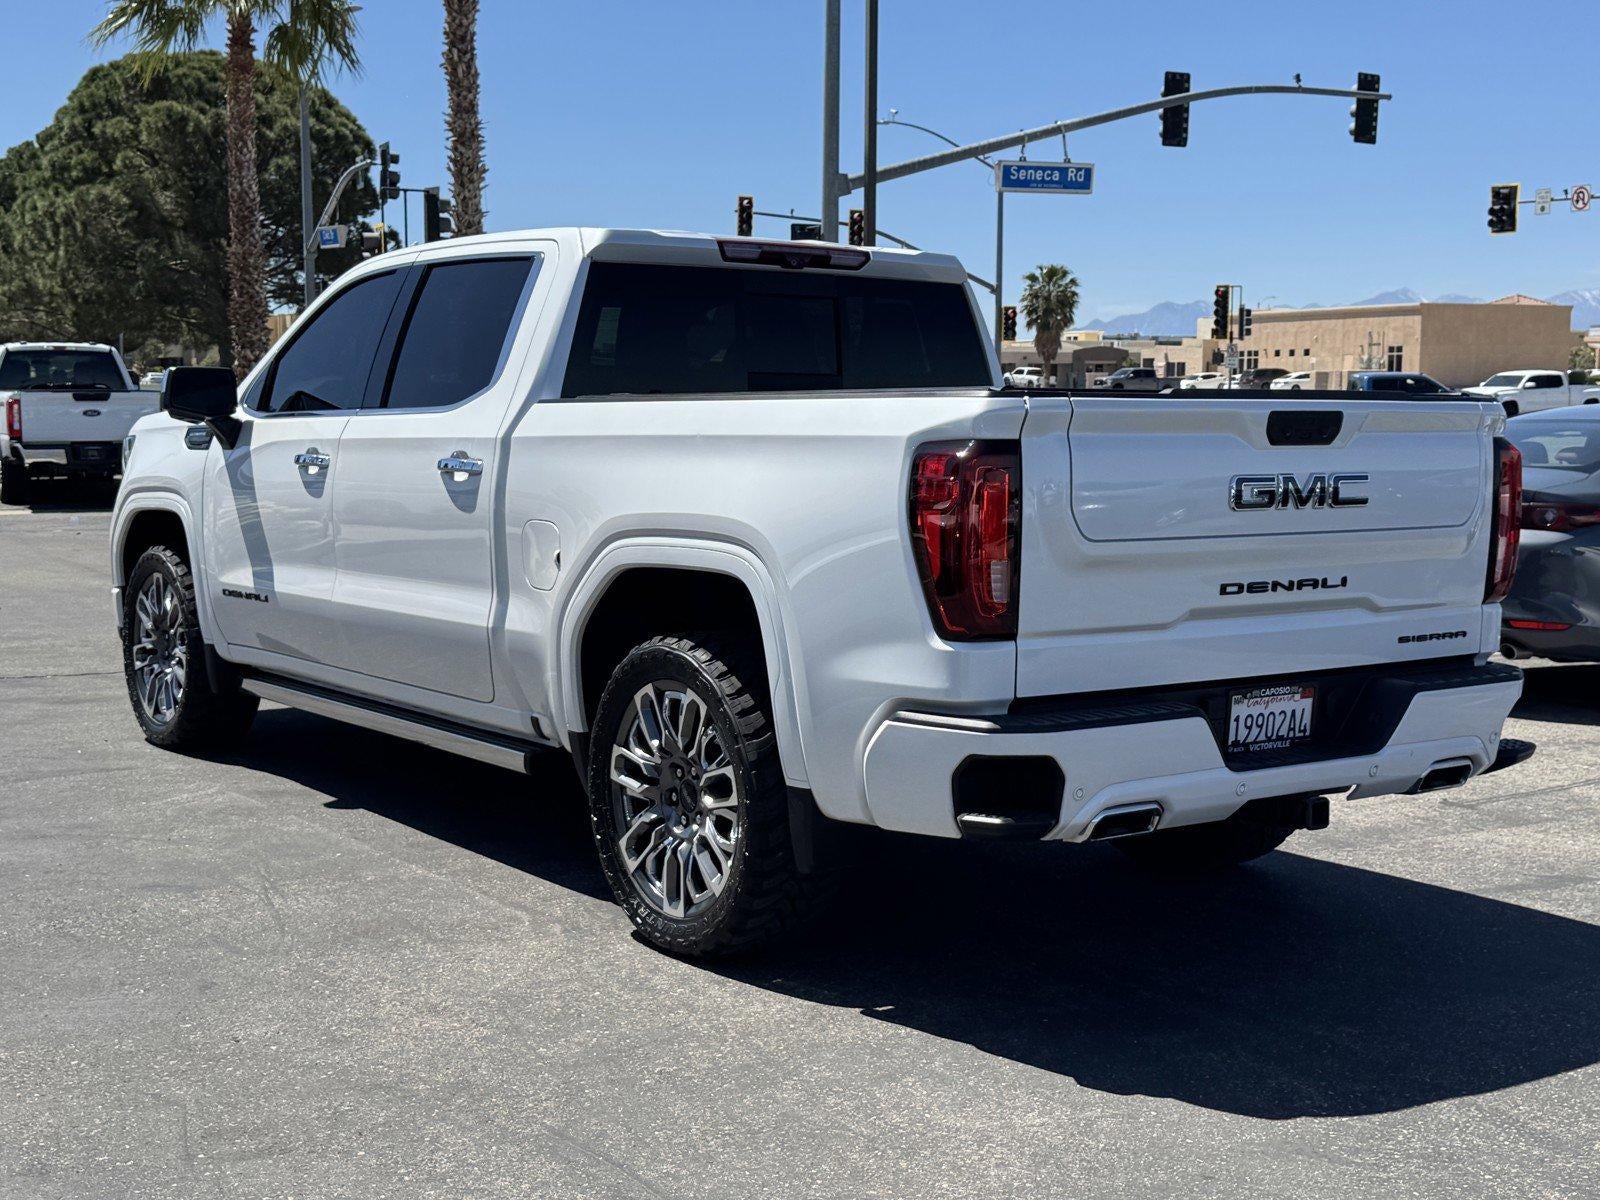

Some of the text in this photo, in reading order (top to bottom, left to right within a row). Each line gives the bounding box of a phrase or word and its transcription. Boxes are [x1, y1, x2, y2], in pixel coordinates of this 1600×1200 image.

[1010, 166, 1085, 182] Seneca Rd
[1228, 472, 1369, 511] GMC
[1219, 575, 1348, 596] DENALI
[222, 588, 269, 603] DENALI
[1397, 630, 1467, 643] SIERRA
[1247, 695, 1301, 709] California
[1231, 708, 1307, 744] 19902A4
[1249, 740, 1291, 751] VICTORVILLE
